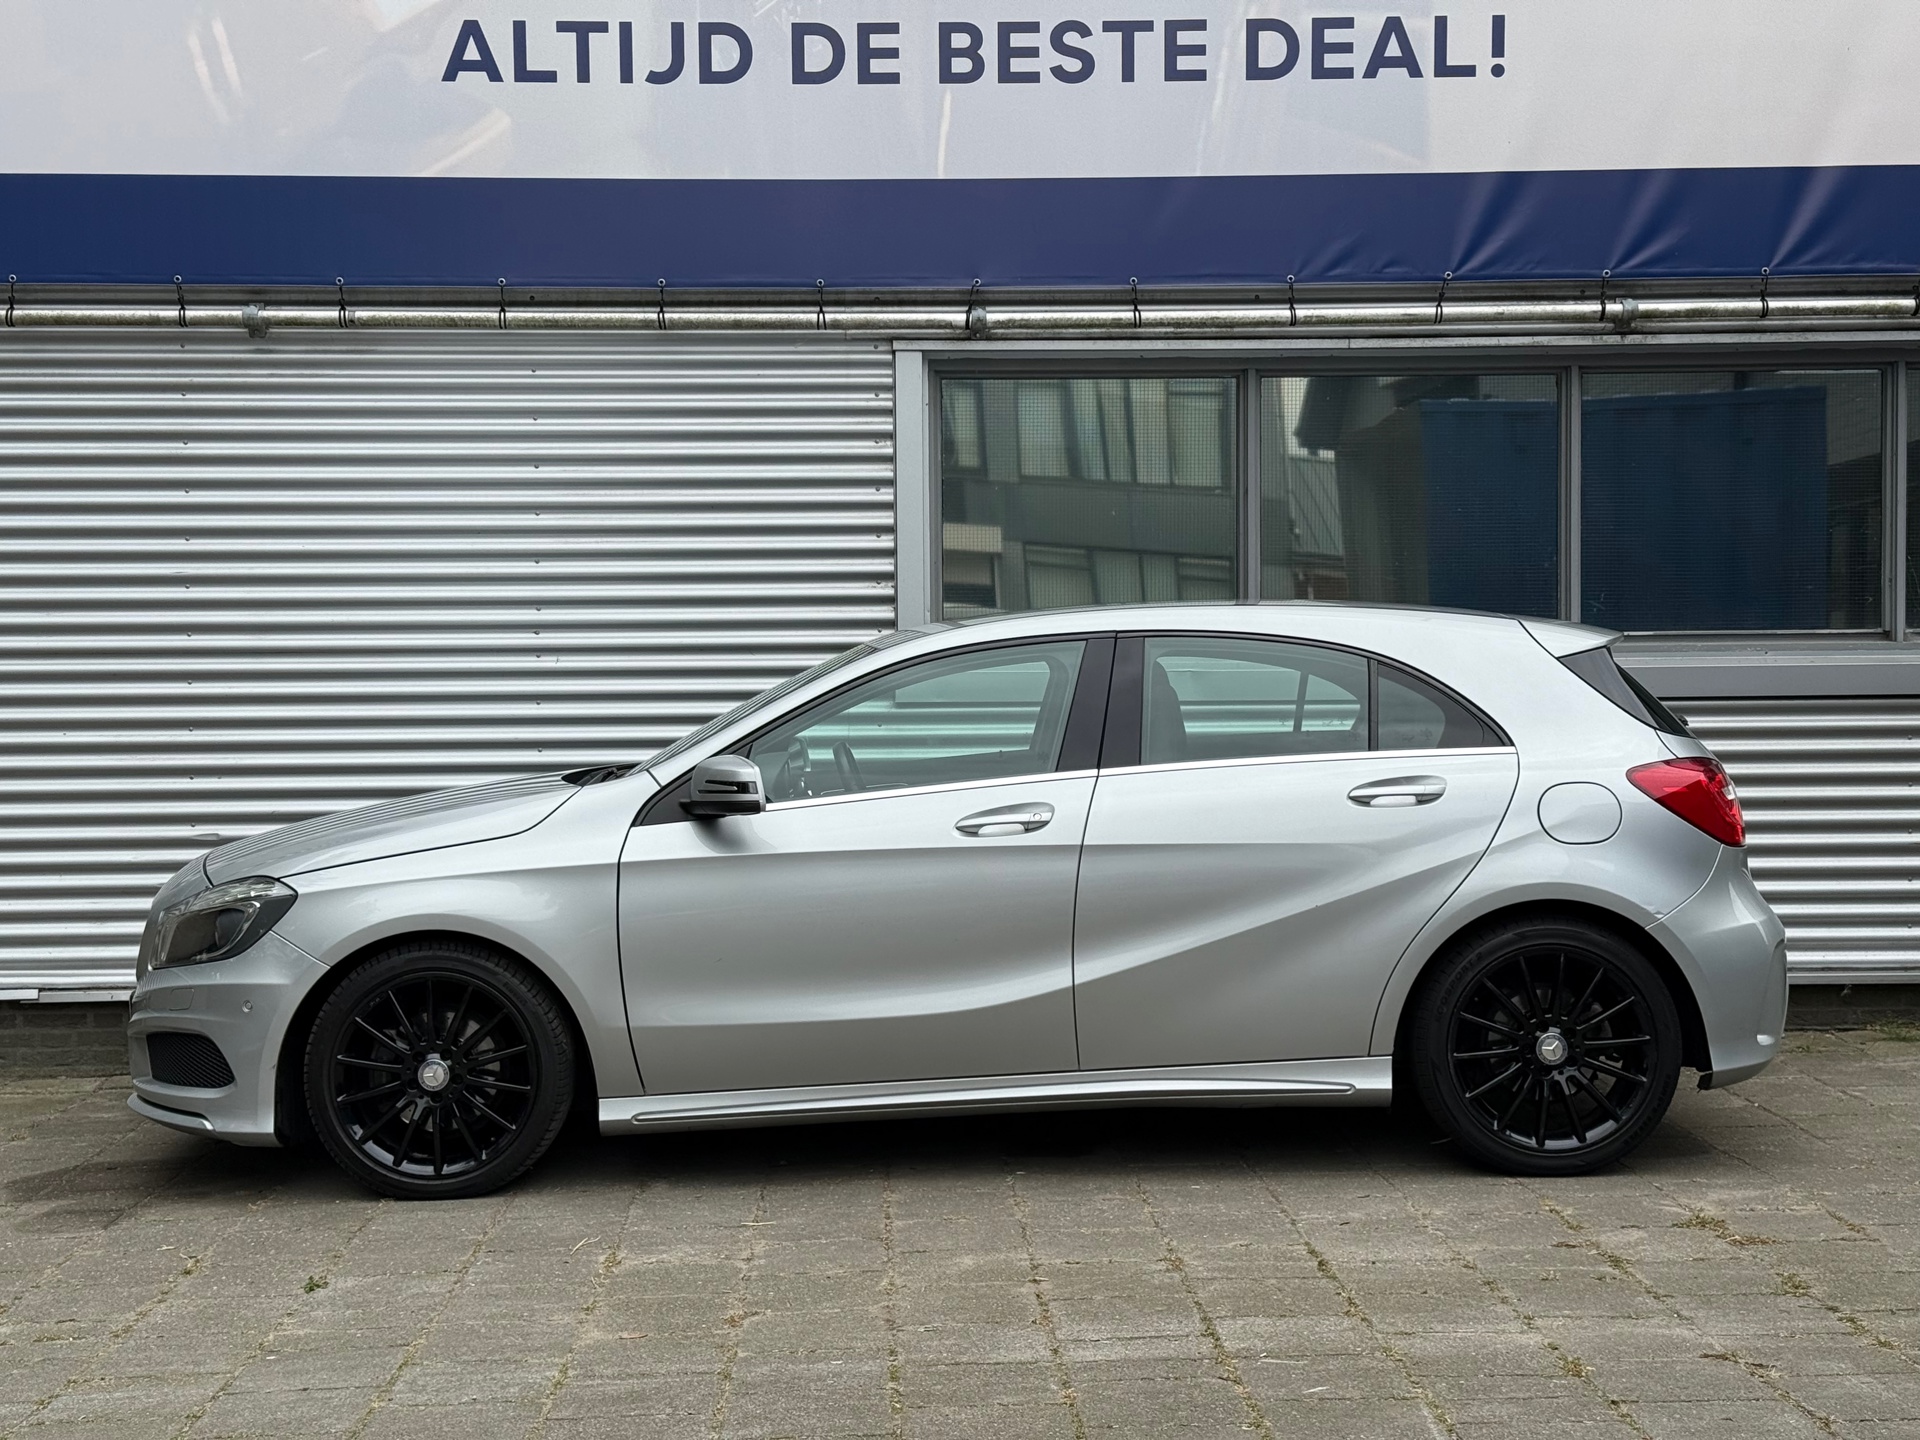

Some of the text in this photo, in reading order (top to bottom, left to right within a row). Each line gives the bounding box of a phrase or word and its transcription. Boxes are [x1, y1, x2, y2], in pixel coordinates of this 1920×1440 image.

[441, 14, 1506, 85] ALTIJD DE BESTE DEAL!
